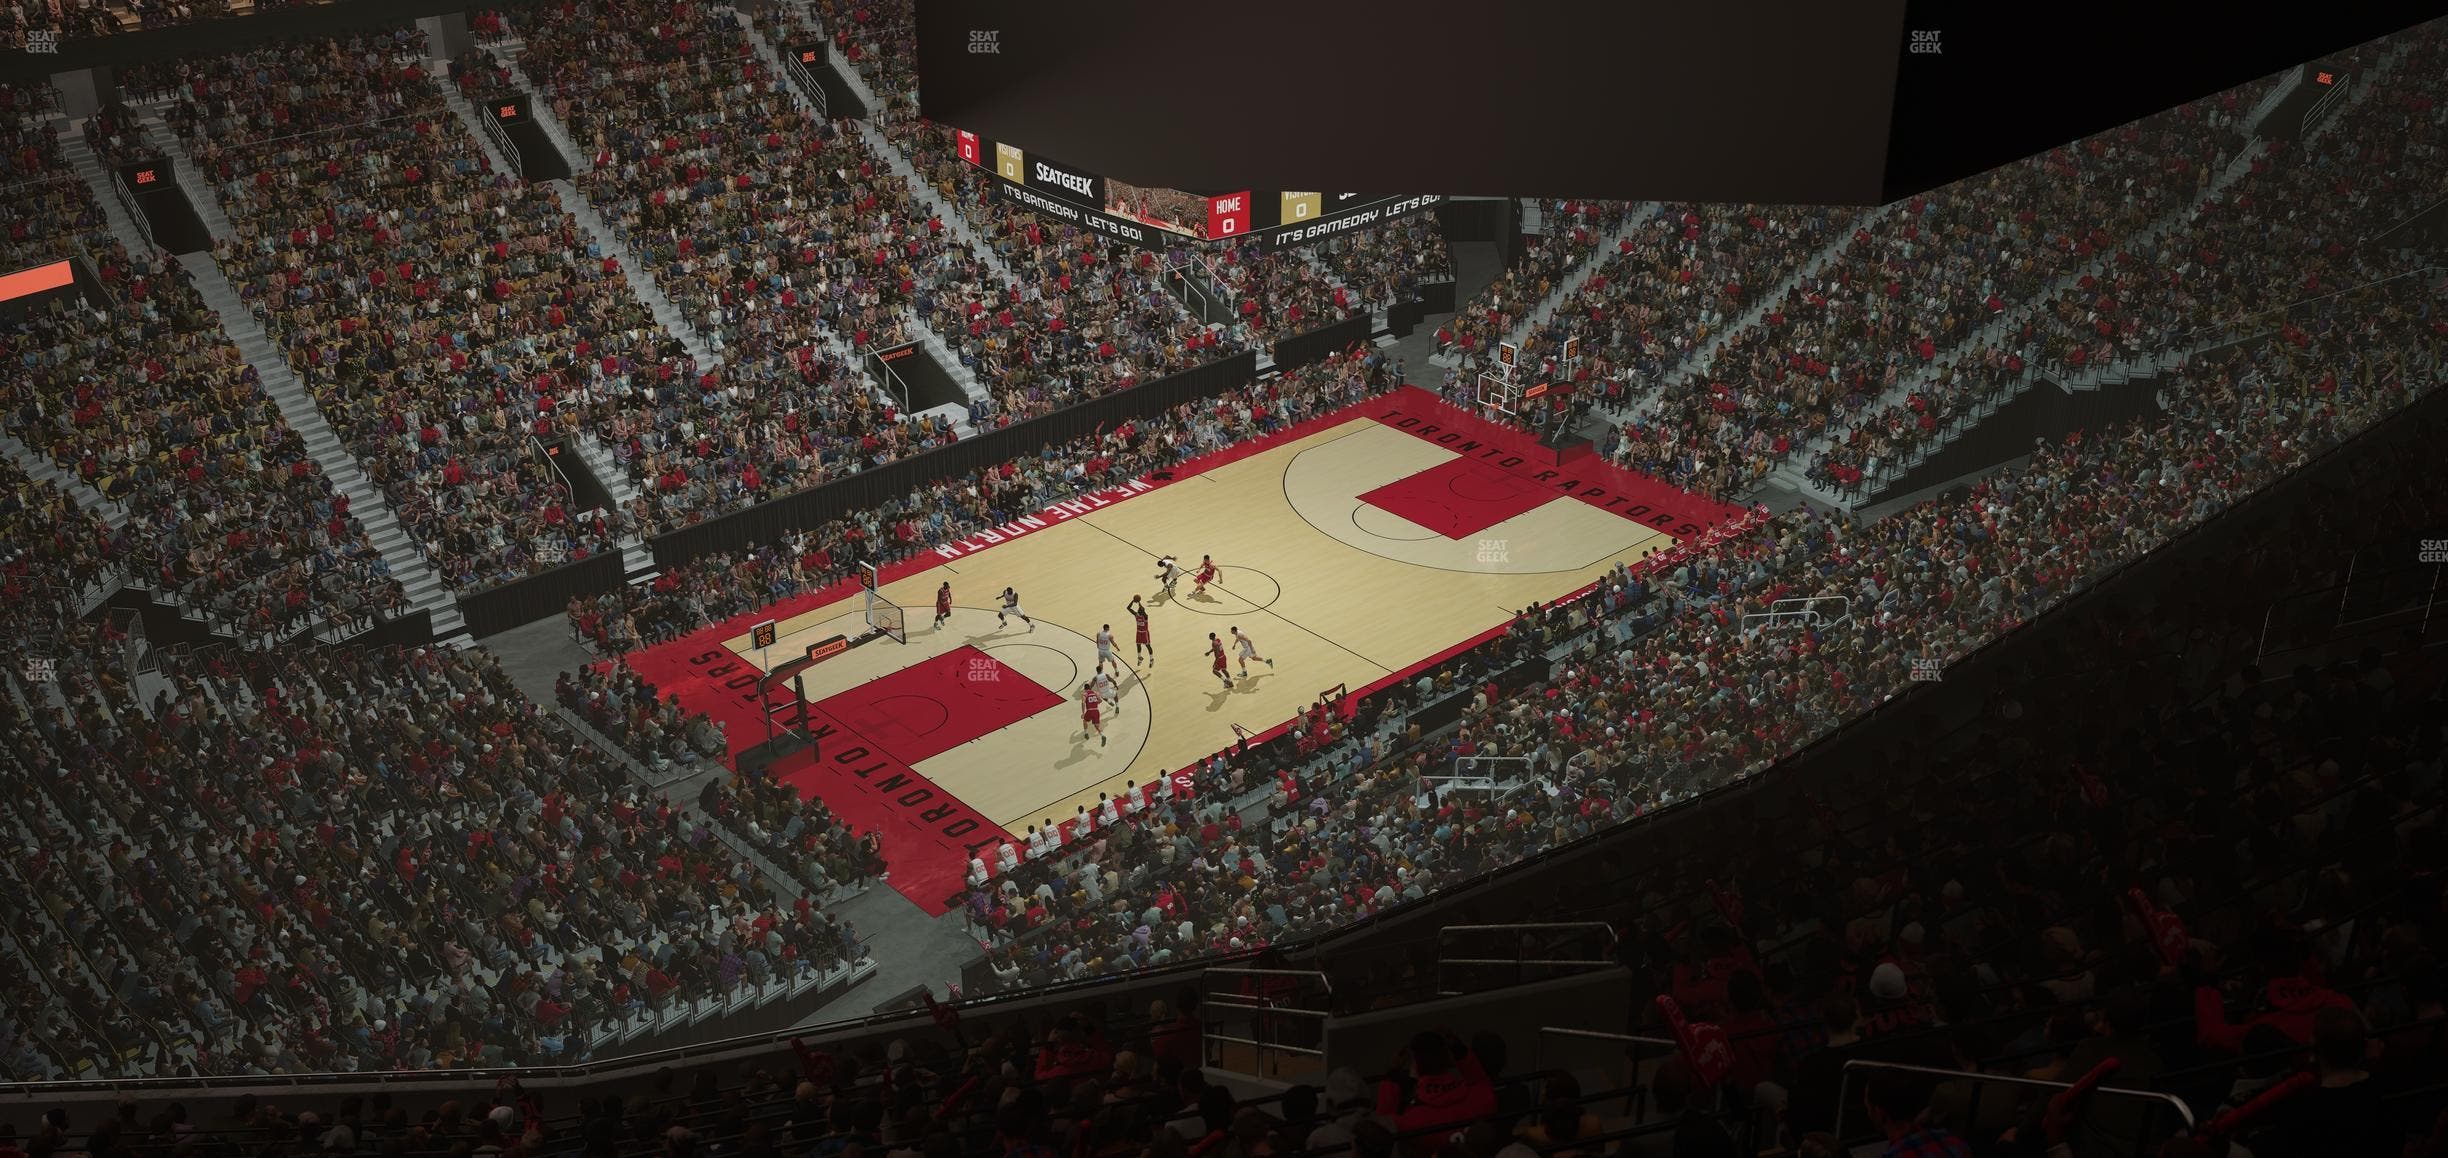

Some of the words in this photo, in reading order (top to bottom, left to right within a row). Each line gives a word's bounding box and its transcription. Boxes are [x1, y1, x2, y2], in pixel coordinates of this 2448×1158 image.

[965, 144, 972, 158] 0
[1007, 162, 1014, 176] 0
[1035, 161, 1094, 199] SEATGEEK
[1003, 183, 1022, 200] IT'S
[1023, 189, 1079, 220] GAMEDAY
[1085, 214, 1118, 234] LET'S
[1120, 225, 1143, 241] GO!
[1216, 197, 1241, 214] HOME
[1296, 203, 1307, 218] 0
[1223, 218, 1235, 234] 0
[1275, 229, 1303, 246] IT'S
[1305, 209, 1379, 238] GAMEDAY
[1385, 197, 1420, 217] LET'S
[881, 347, 914, 361] SEATGEEK
[1380, 409, 1524, 469] TORONTO
[1533, 470, 1702, 536] RAPTORS
[1044, 494, 1111, 519] THE
[935, 515, 1047, 559] NORTH
[815, 641, 843, 657] SEATGEEK
[834, 746, 1006, 854] TORONTO
